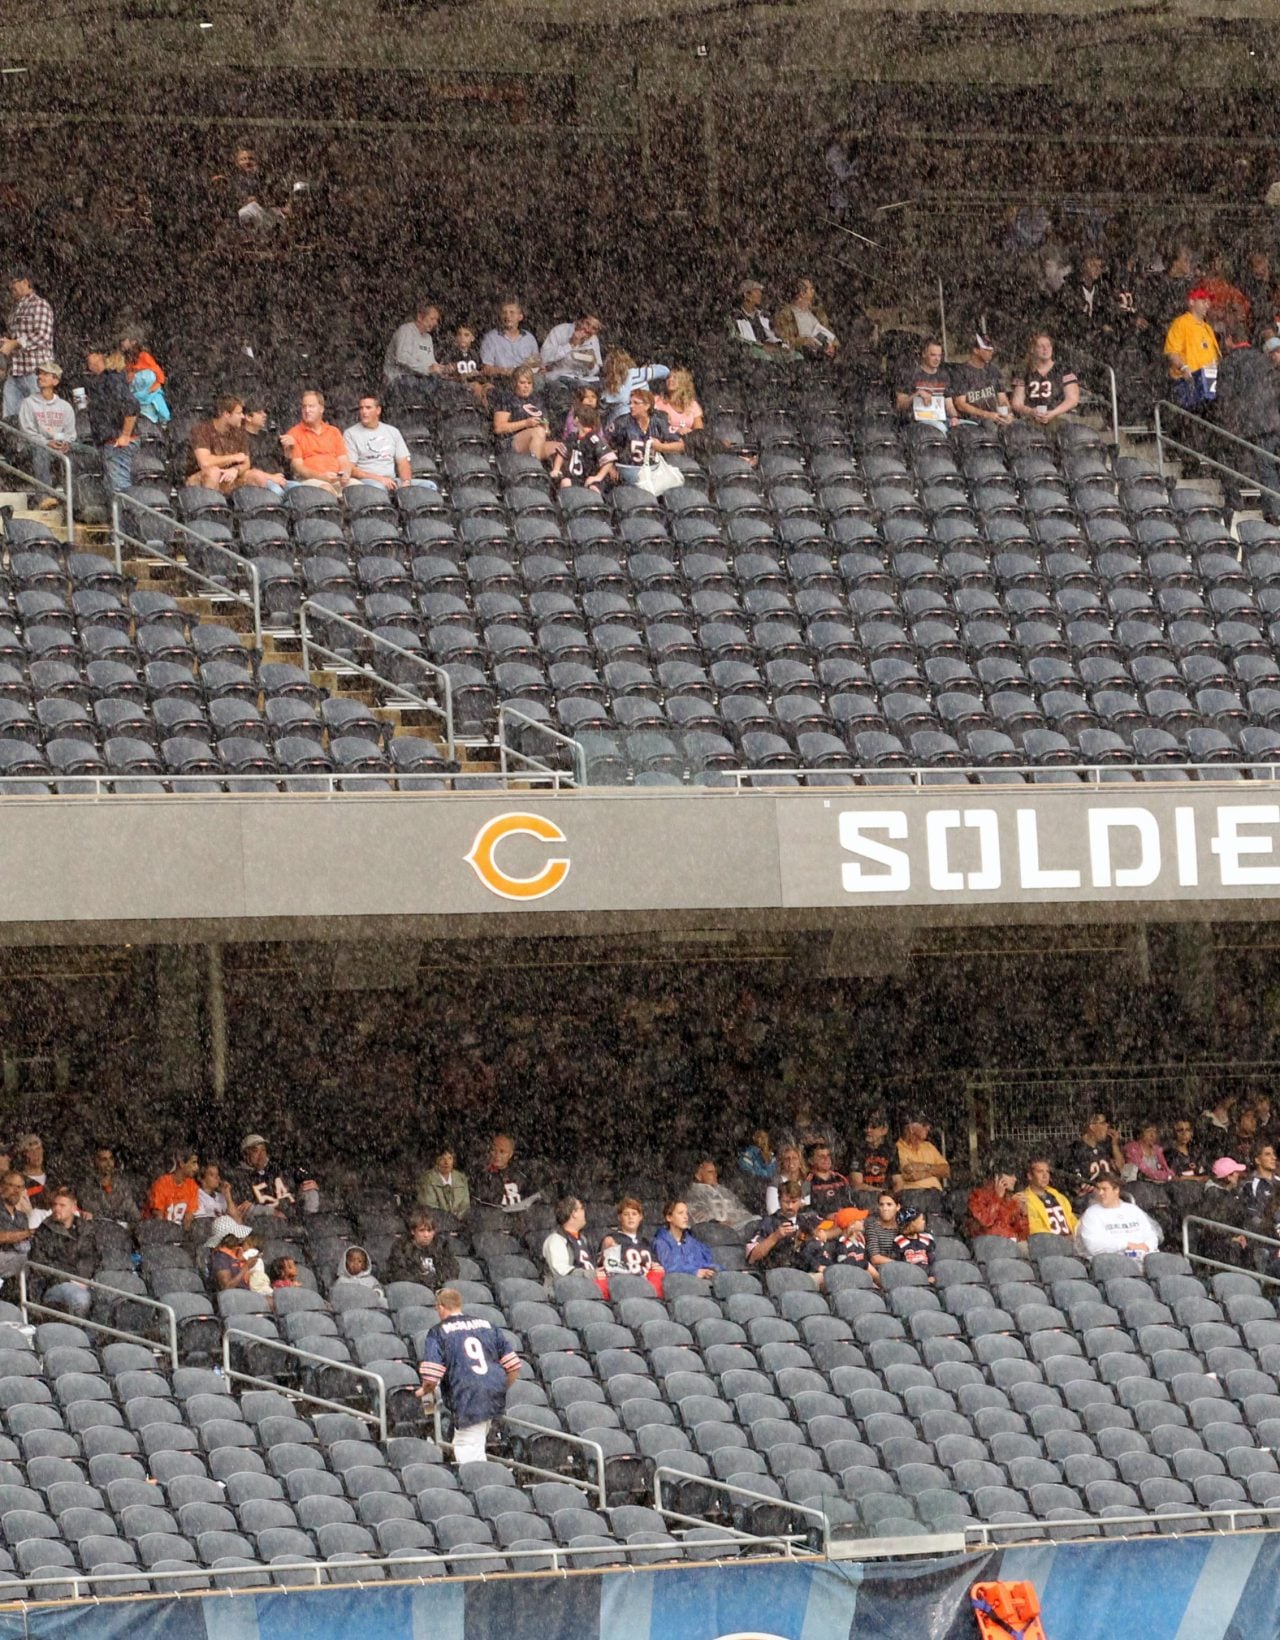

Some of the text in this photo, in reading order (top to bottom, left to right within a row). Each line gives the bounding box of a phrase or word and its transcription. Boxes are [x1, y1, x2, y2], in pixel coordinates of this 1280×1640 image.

[1029, 381, 1052, 398] 23
[462, 811, 571, 901] C
[252, 1177, 295, 1206] 54
[1045, 1205, 1070, 1235] 55
[464, 1336, 489, 1376] 9
